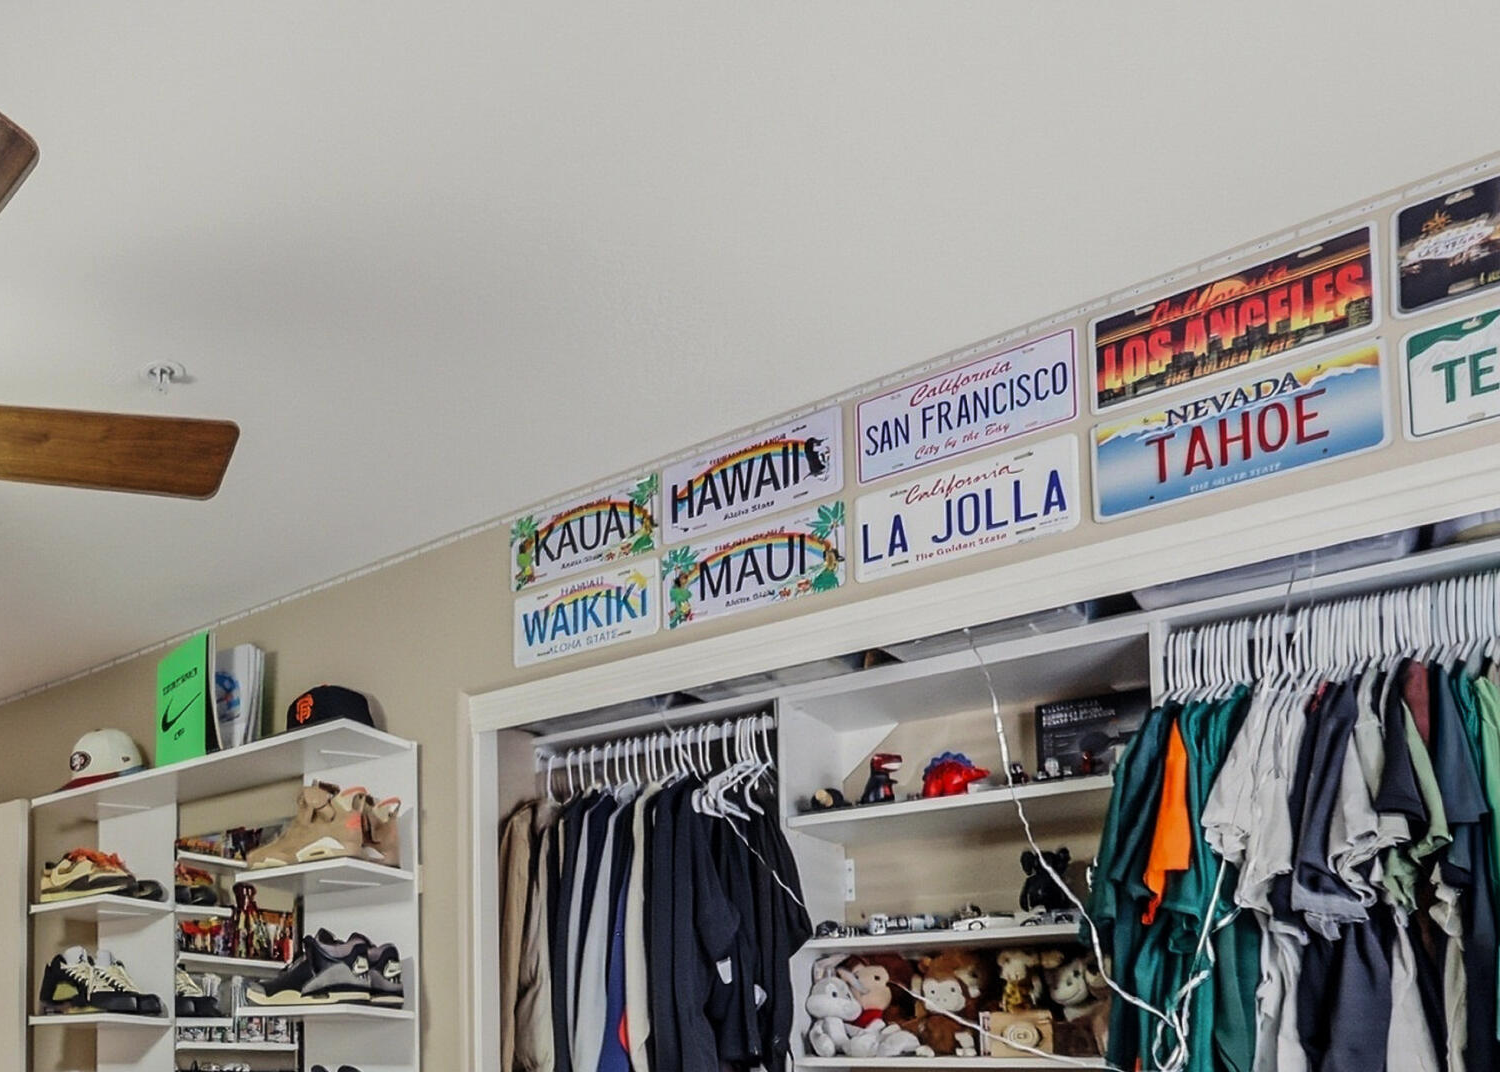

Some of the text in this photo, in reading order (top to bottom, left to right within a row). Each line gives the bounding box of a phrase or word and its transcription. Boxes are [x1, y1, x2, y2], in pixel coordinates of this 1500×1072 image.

[1104, 264, 1364, 390] LOS ANGELES
[865, 361, 1068, 456] SAN FRANCISCO
[909, 360, 1013, 407] California
[1165, 371, 1301, 428] NEVADA
[1145, 388, 1329, 484] TAHOE
[672, 441, 800, 524] HAWAII
[862, 469, 1067, 564] LA JOLLA
[905, 462, 1024, 505] California
[534, 499, 636, 567] KAUAI
[700, 533, 806, 601] MAUI
[523, 583, 647, 647] WAIKIKI
